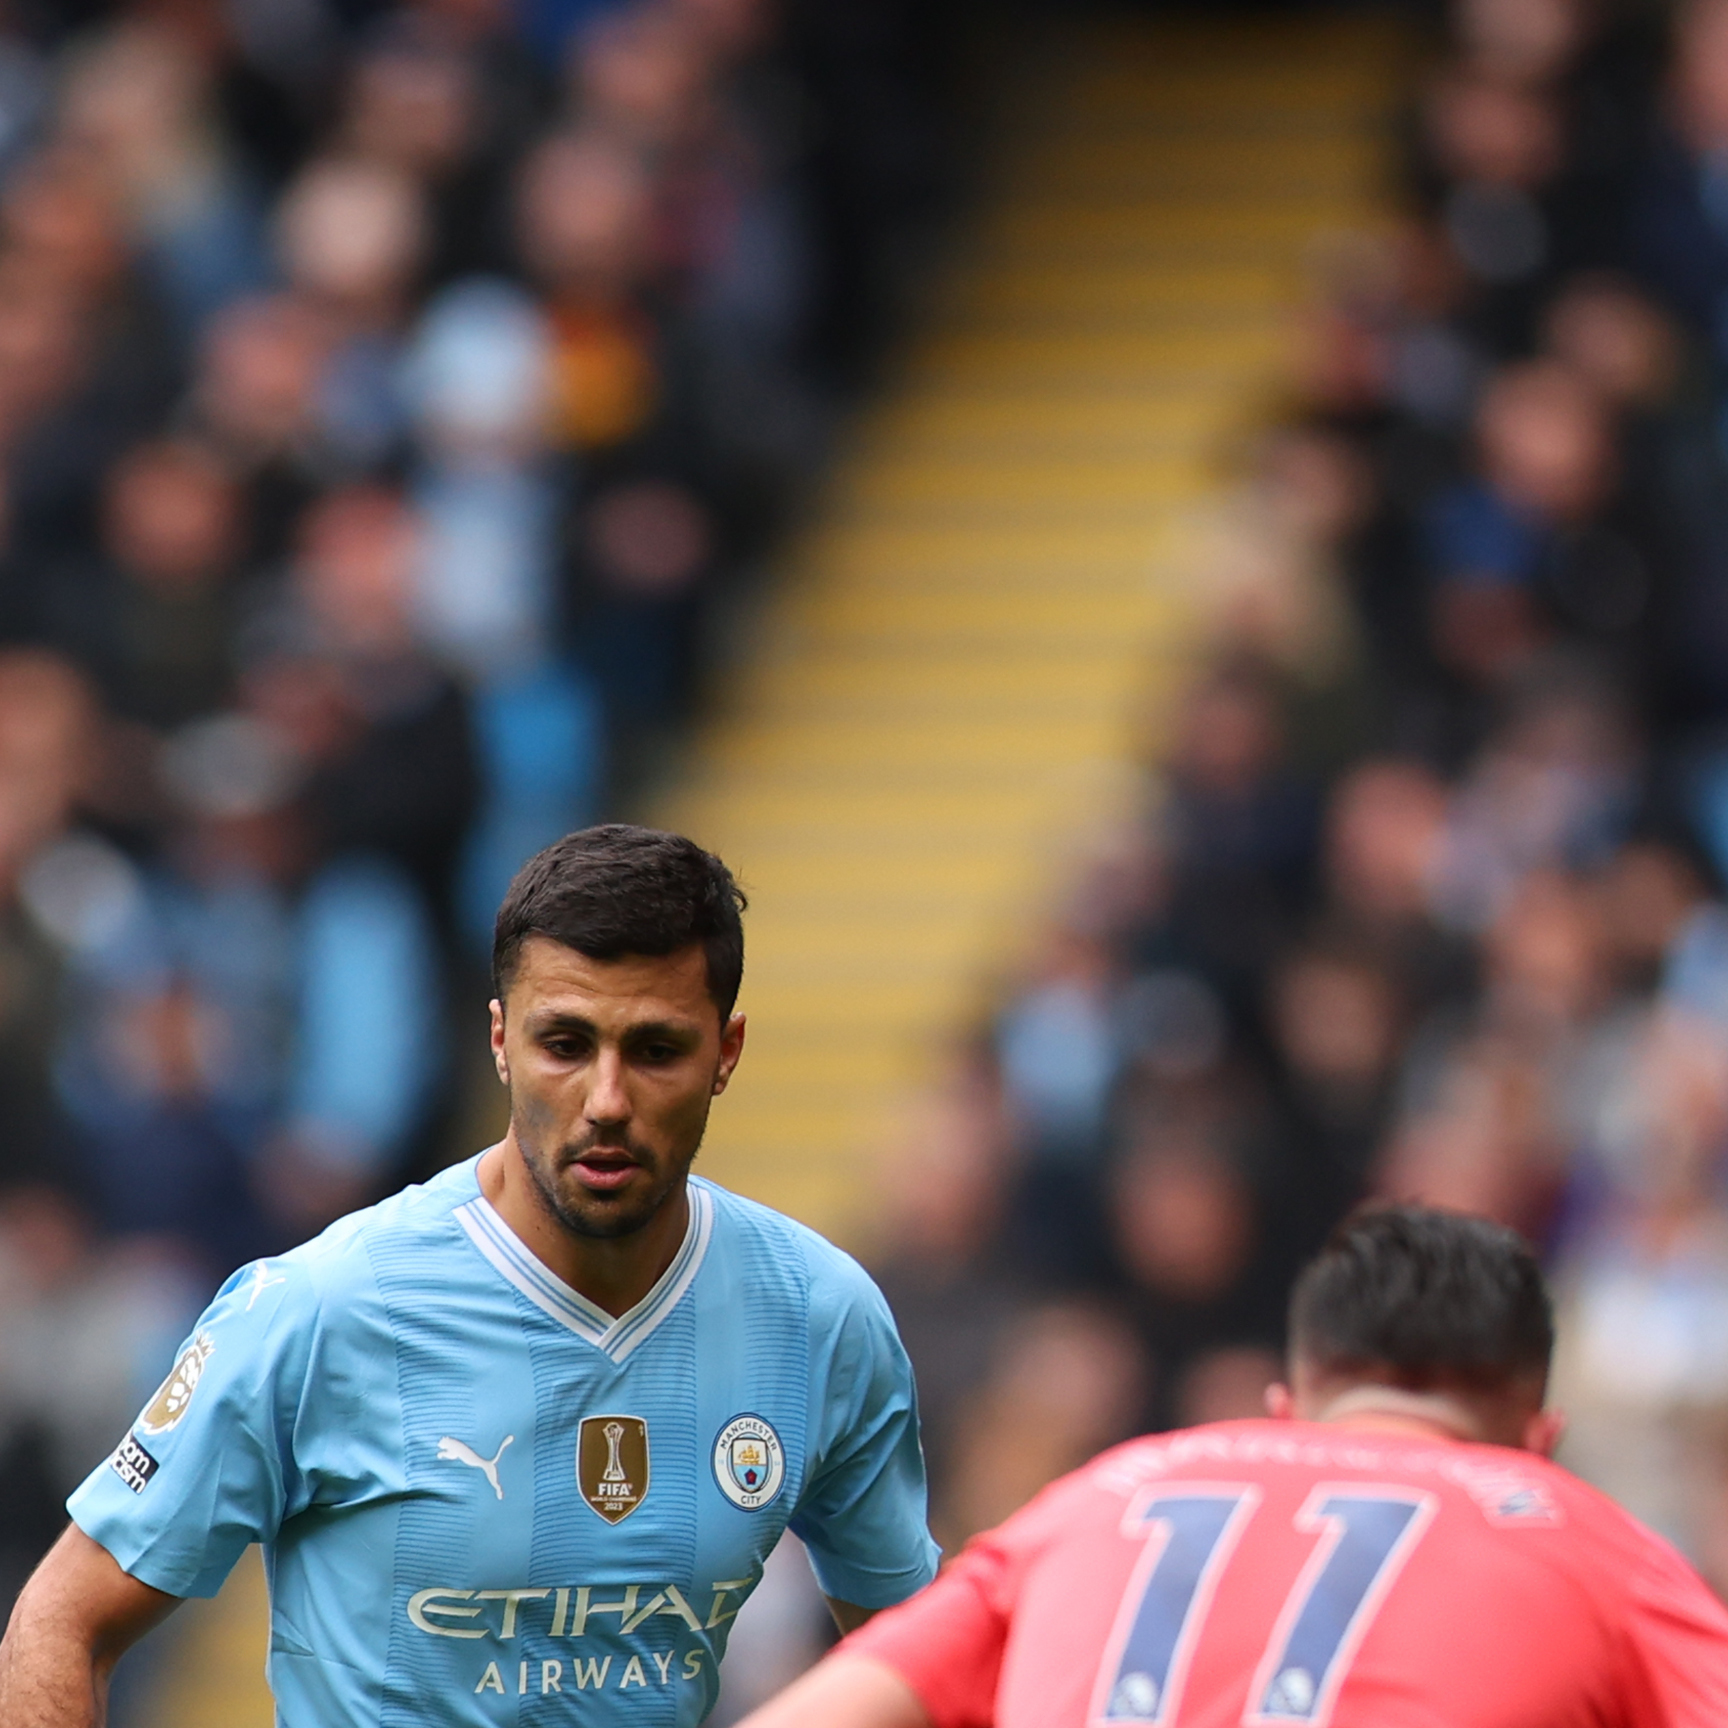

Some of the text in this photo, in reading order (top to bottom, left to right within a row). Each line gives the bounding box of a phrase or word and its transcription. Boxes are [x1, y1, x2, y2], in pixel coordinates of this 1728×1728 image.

[720, 1420, 778, 1451] MANCHESTER
[598, 1483, 630, 1496] FIFA
[740, 1495, 762, 1505] CITY
[474, 1649, 704, 1695] AIRWAYS
